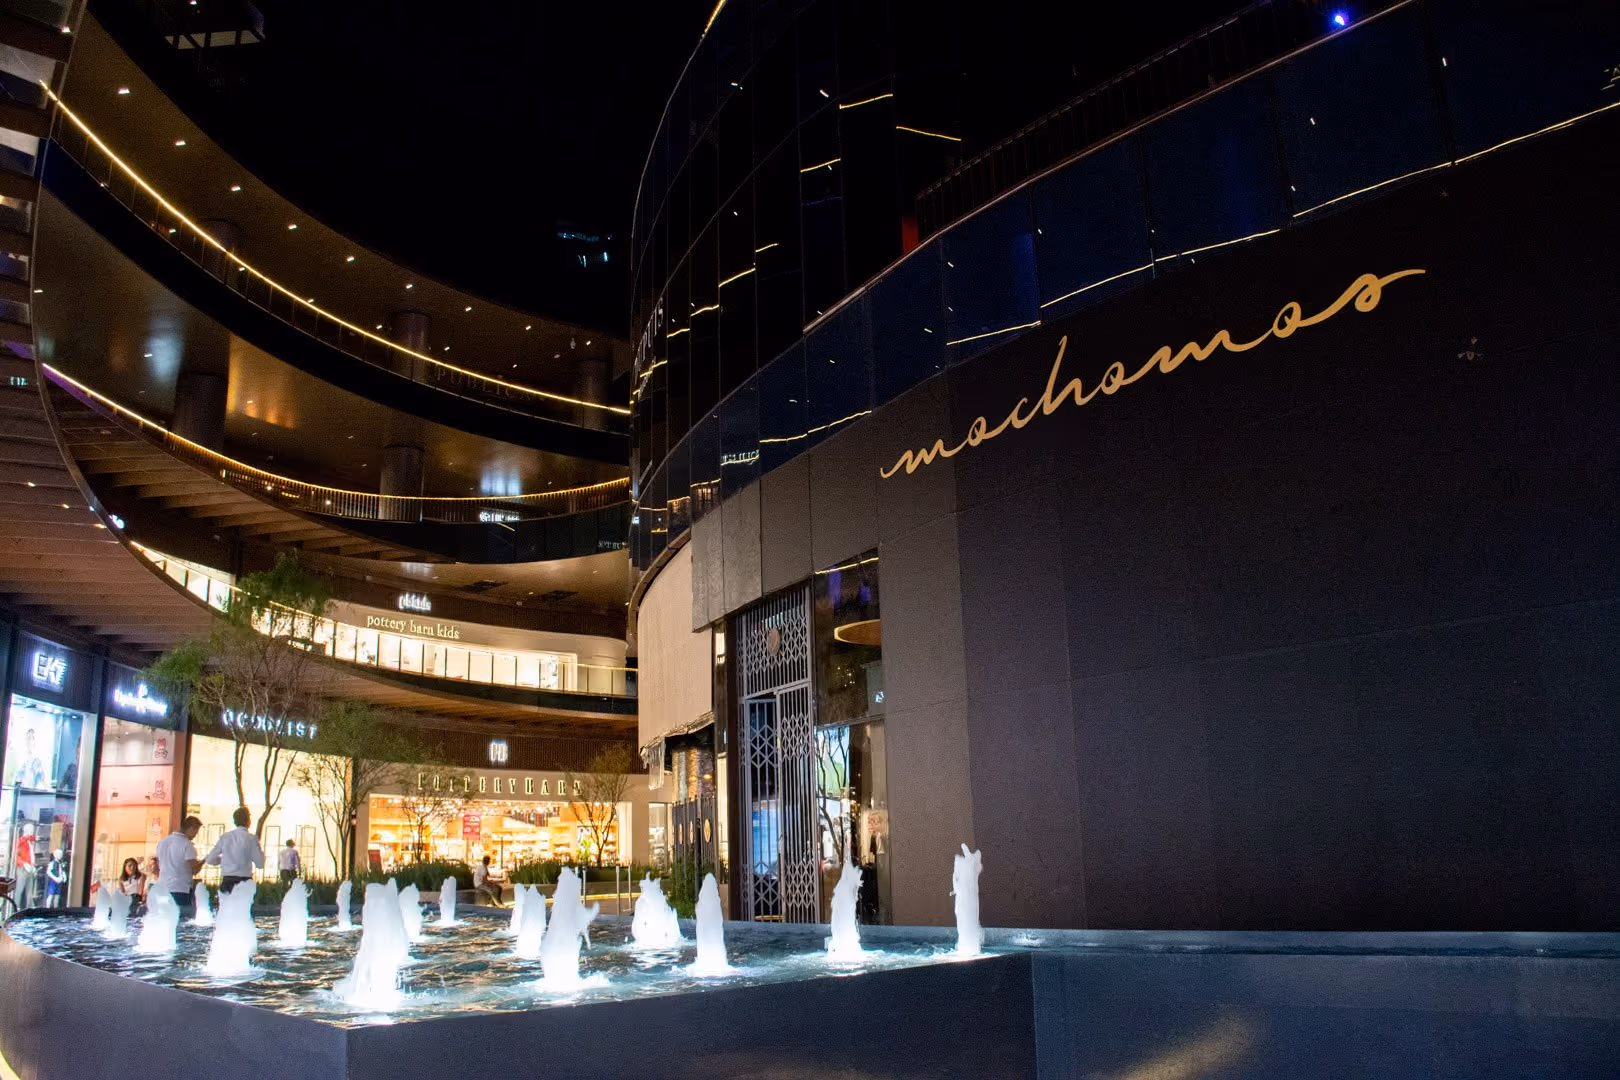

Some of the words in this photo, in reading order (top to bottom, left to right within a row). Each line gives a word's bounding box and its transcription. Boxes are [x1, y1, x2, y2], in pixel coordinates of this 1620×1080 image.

[880, 269, 1426, 479] mochomos
[367, 615, 407, 632] pottery
[409, 619, 435, 636] barn
[437, 624, 460, 639] kids
